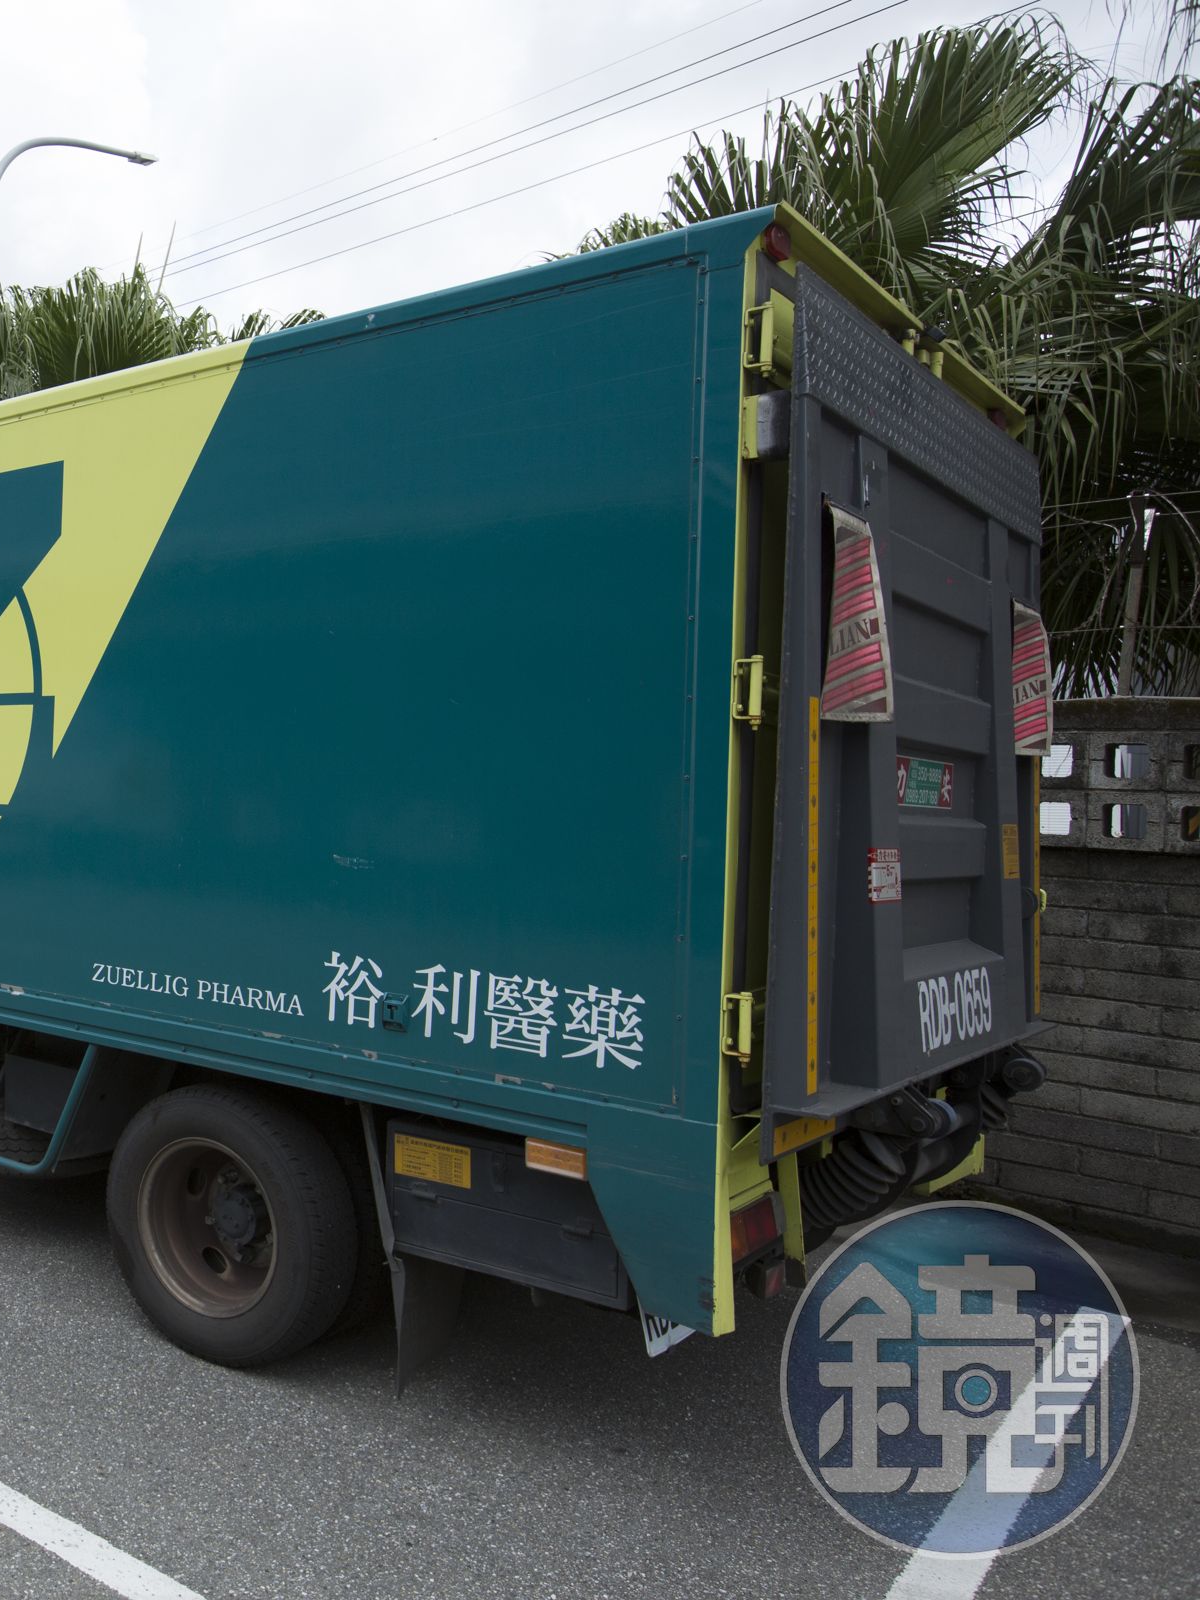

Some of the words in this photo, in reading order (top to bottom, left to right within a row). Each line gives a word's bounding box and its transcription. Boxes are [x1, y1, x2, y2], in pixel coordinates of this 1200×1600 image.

[91, 963, 189, 998] ZUELLIG
[196, 979, 304, 1017] PHARMA
[321, 950, 646, 1070] 裕利醫藥
[917, 966, 992, 1053] RDB-0659
